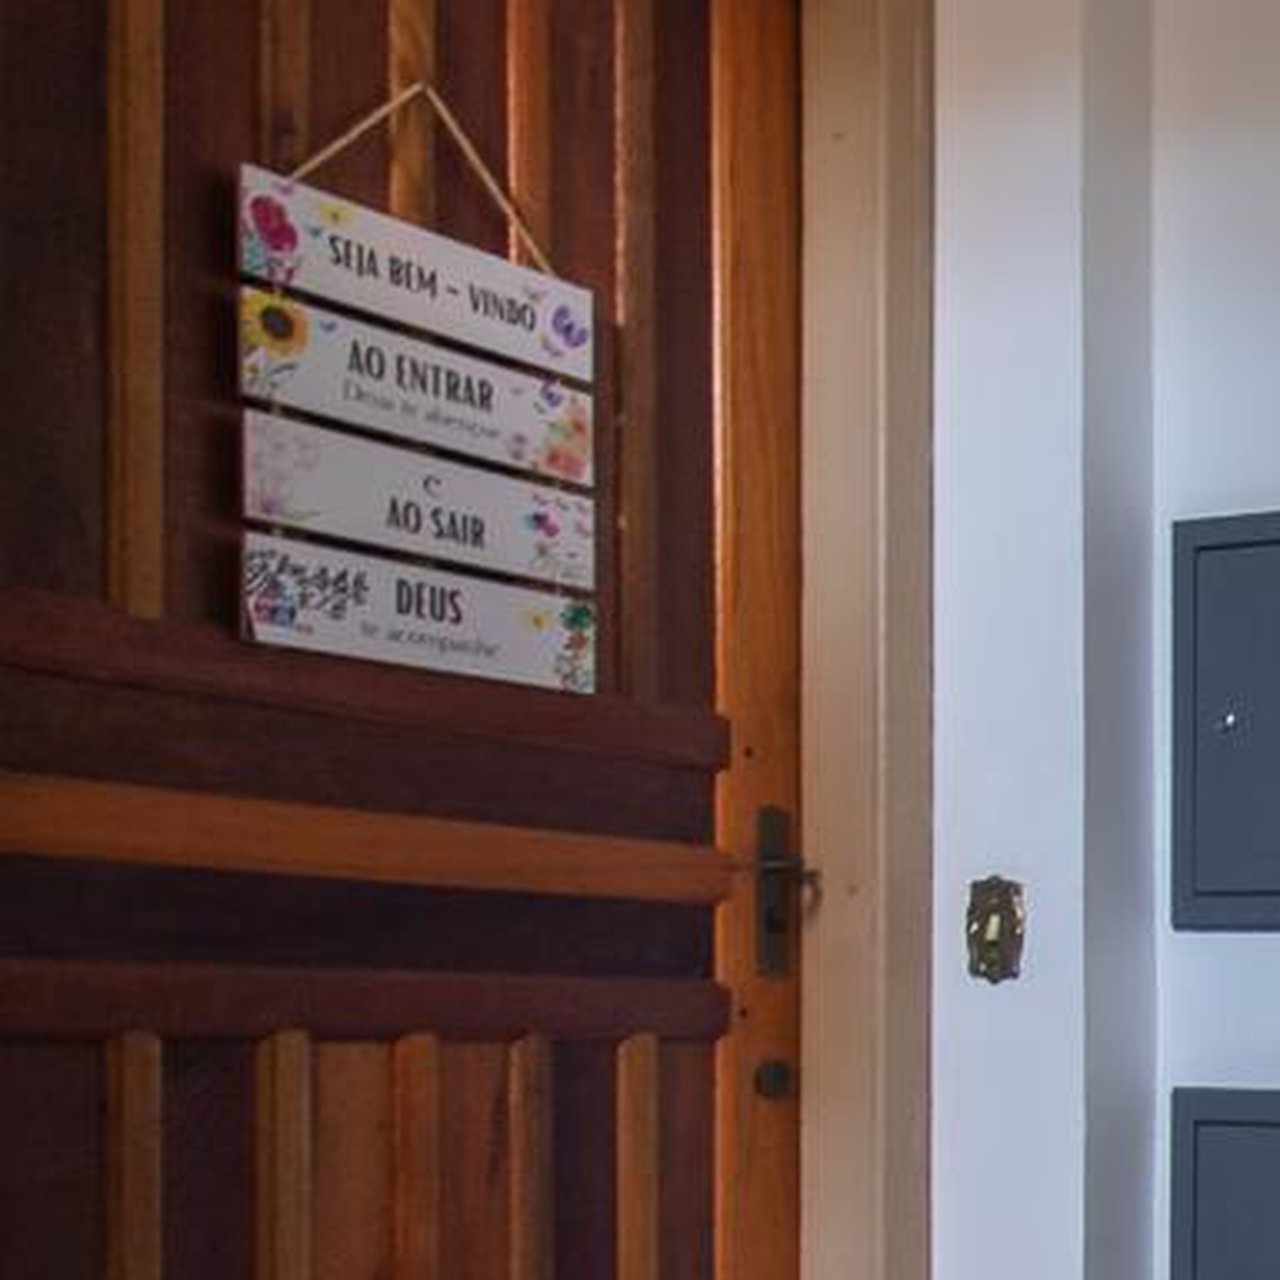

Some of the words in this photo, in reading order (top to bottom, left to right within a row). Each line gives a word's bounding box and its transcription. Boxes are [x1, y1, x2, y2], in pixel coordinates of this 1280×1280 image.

[328, 234, 379, 279] SEJA
[389, 254, 437, 300] BEM
[468, 283, 536, 332] VINDO
[348, 338, 385, 381] AO
[396, 354, 493, 412] ENTRAR
[385, 497, 422, 534] AO
[430, 506, 485, 549] SAIR
[396, 578, 463, 626] DEUS
